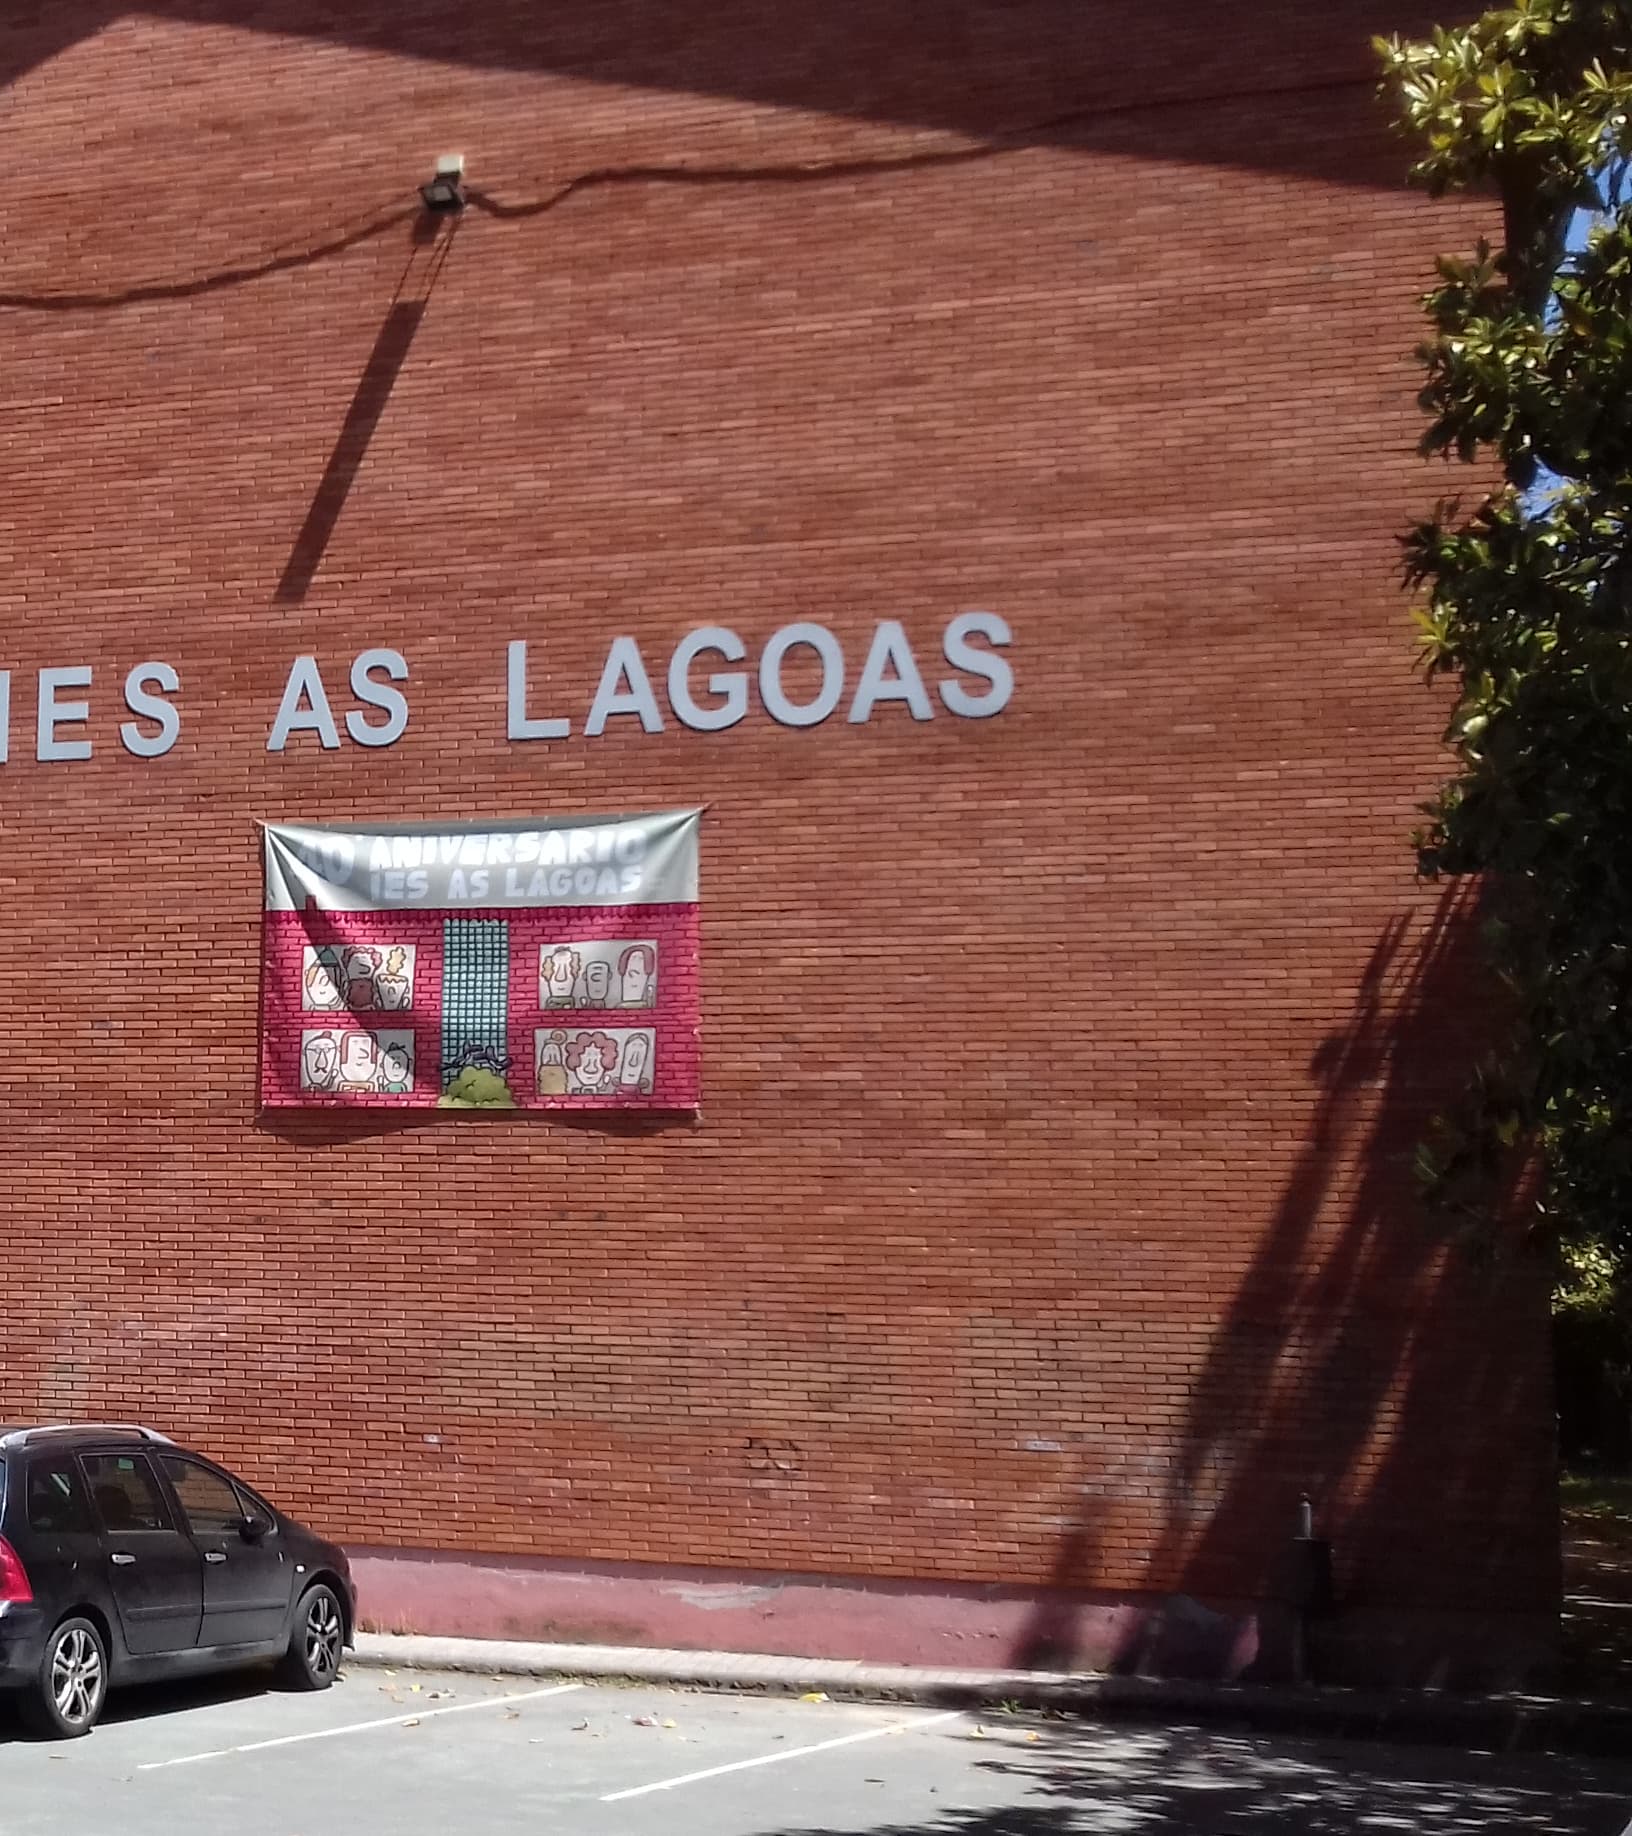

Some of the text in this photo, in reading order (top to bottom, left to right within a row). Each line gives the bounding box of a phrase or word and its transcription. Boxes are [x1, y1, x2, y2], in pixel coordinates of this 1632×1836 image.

[267, 648, 410, 751] AS
[507, 611, 1015, 741] LAGOAS
[369, 827, 649, 871] ANIVERSARIO
[371, 864, 643, 902] IES AS LAGOAS
